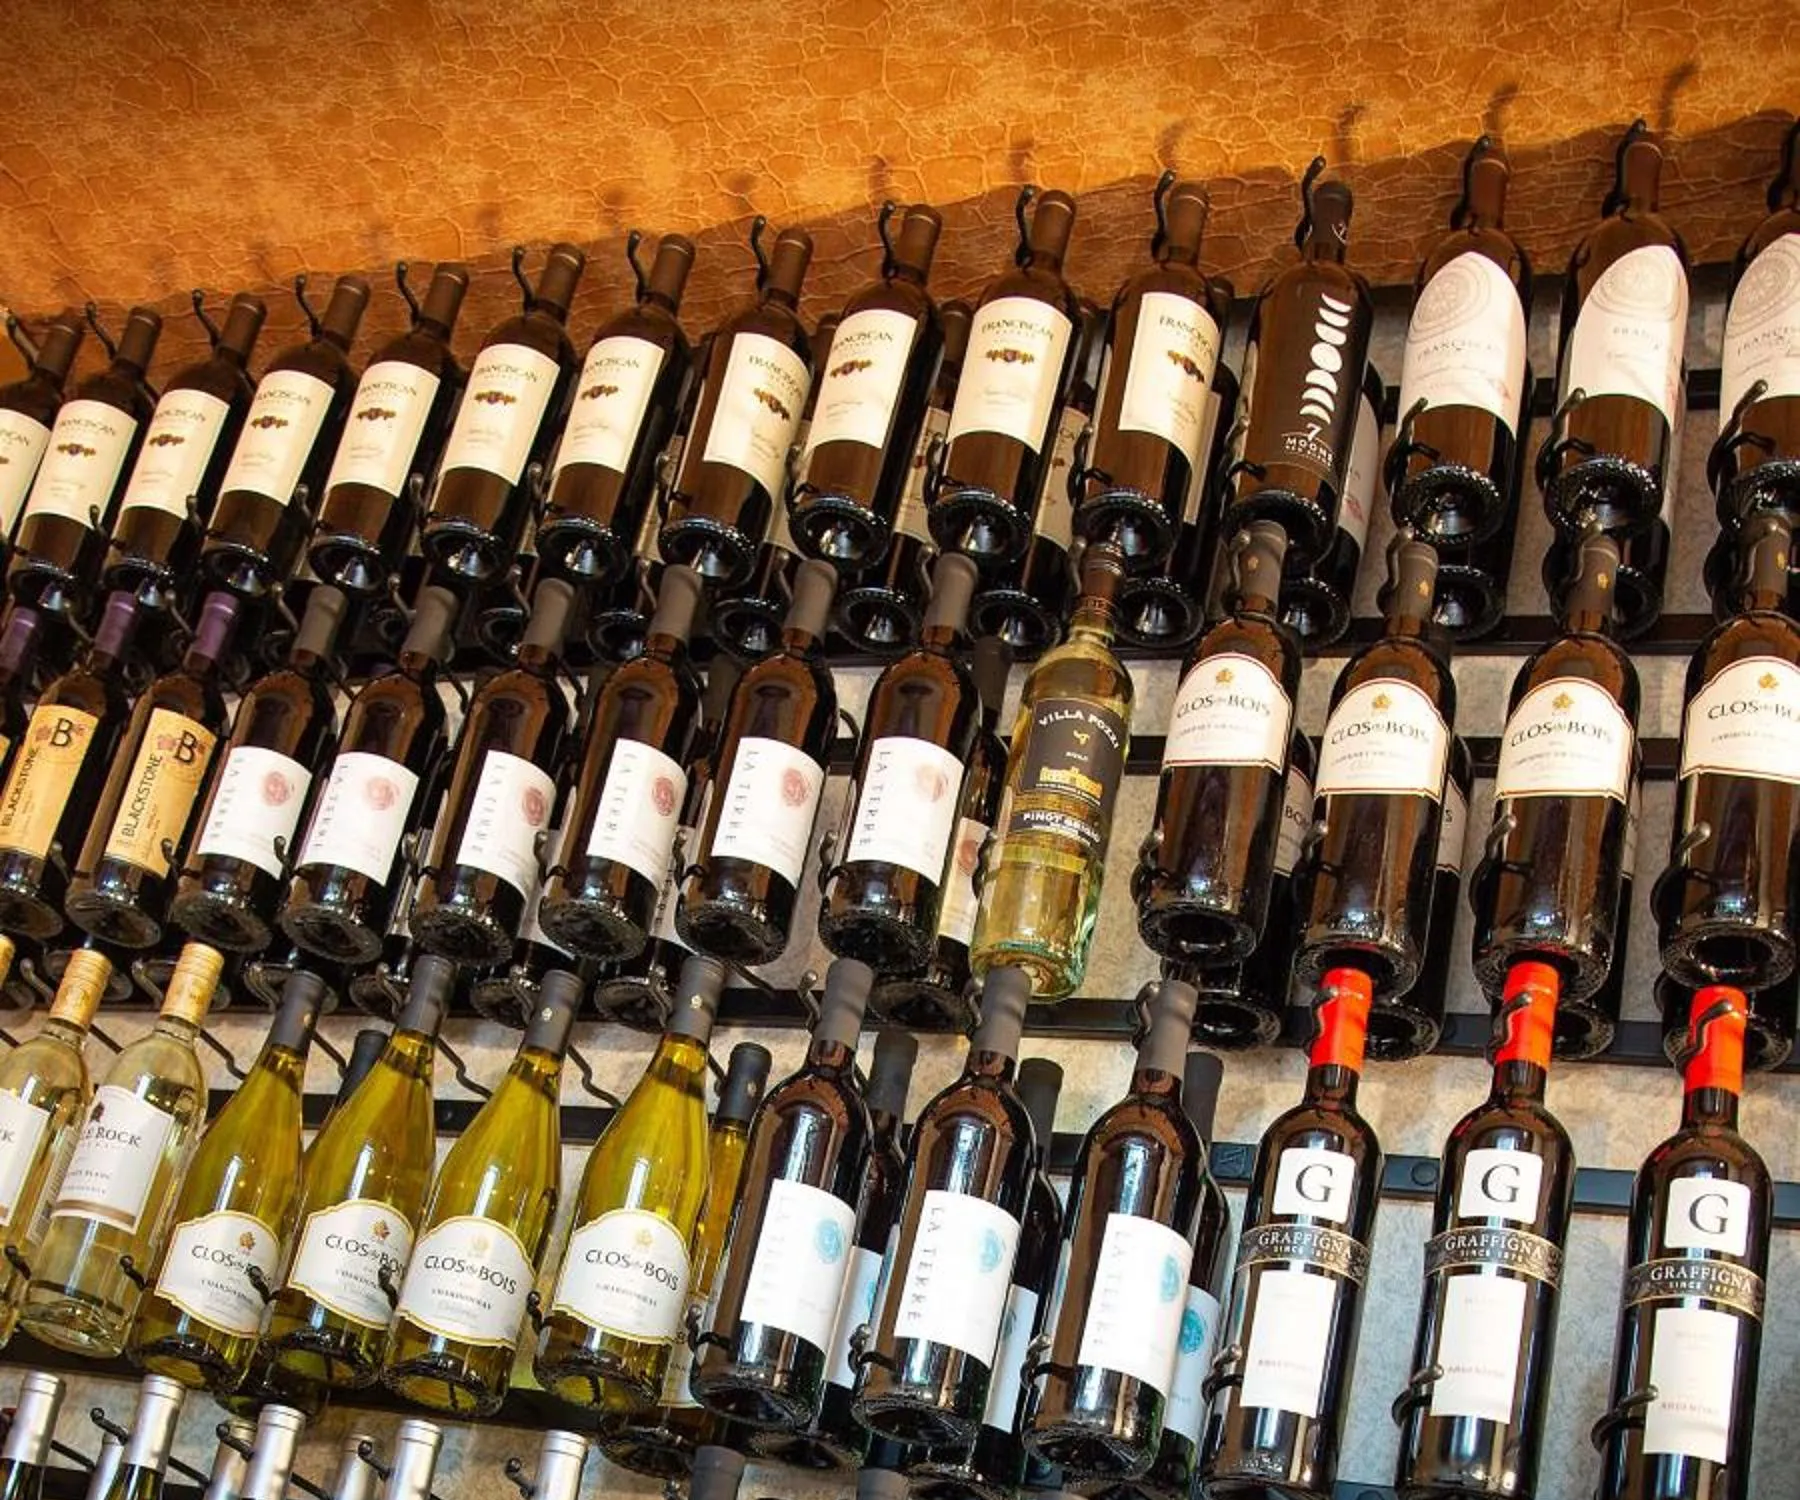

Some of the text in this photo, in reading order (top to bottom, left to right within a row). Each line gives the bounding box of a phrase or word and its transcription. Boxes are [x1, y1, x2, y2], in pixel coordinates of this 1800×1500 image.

[1306, 422, 1323, 442] 7
[1176, 693, 1271, 719] CLOS BOIS
[1707, 700, 1760, 721] CLOS
[50, 716, 74, 748] B
[1038, 708, 1120, 750] VILLA POZZI
[1330, 720, 1372, 746] CLOS
[1385, 720, 1431, 744] BOIS
[1510, 720, 1553, 748] CLOS
[1567, 720, 1613, 745] BOIS
[173, 729, 199, 766] B
[121, 751, 164, 839] BLACKSTONE
[1022, 811, 1064, 824] PINOT
[95, 1126, 143, 1148] ROCK
[1295, 1163, 1334, 1203] G
[1480, 1163, 1521, 1203] G
[1688, 1192, 1728, 1235] G
[191, 1244, 235, 1267] CLOS
[325, 1233, 370, 1257] CLOS
[1258, 1229, 1351, 1261] GRAFFIGNA
[1445, 1234, 1543, 1261] GRAFFIGNA
[424, 1255, 467, 1273] CLOS
[479, 1265, 518, 1295] BOIS
[585, 1249, 680, 1291] CLOS BOIS
[1651, 1265, 1752, 1293] GRAFFIGNA
